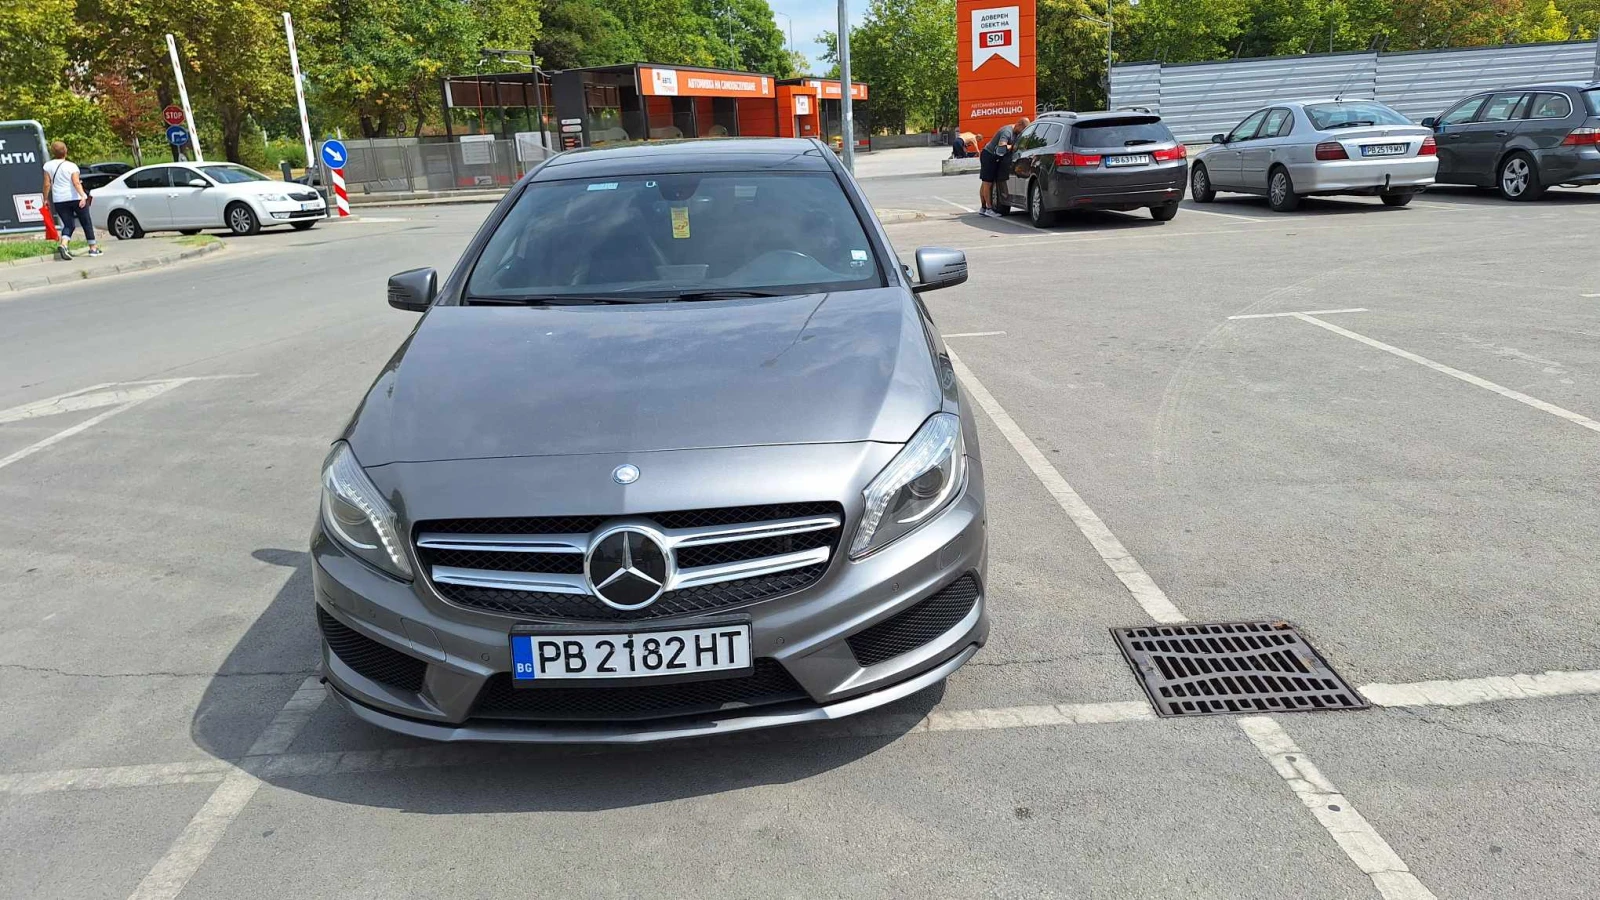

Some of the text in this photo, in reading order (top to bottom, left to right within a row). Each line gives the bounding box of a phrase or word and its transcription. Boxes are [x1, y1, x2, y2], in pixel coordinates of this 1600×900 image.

[981, 13, 1009, 22] ДОВЕРЕН
[988, 33, 1003, 43] SDI
[165, 111, 183, 119] STOP
[971, 106, 1023, 118] ДЕНОНОЩНО
[0, 152, 36, 164] НТИ
[537, 630, 742, 674] PB 2182 HT
[517, 662, 533, 674] BG
